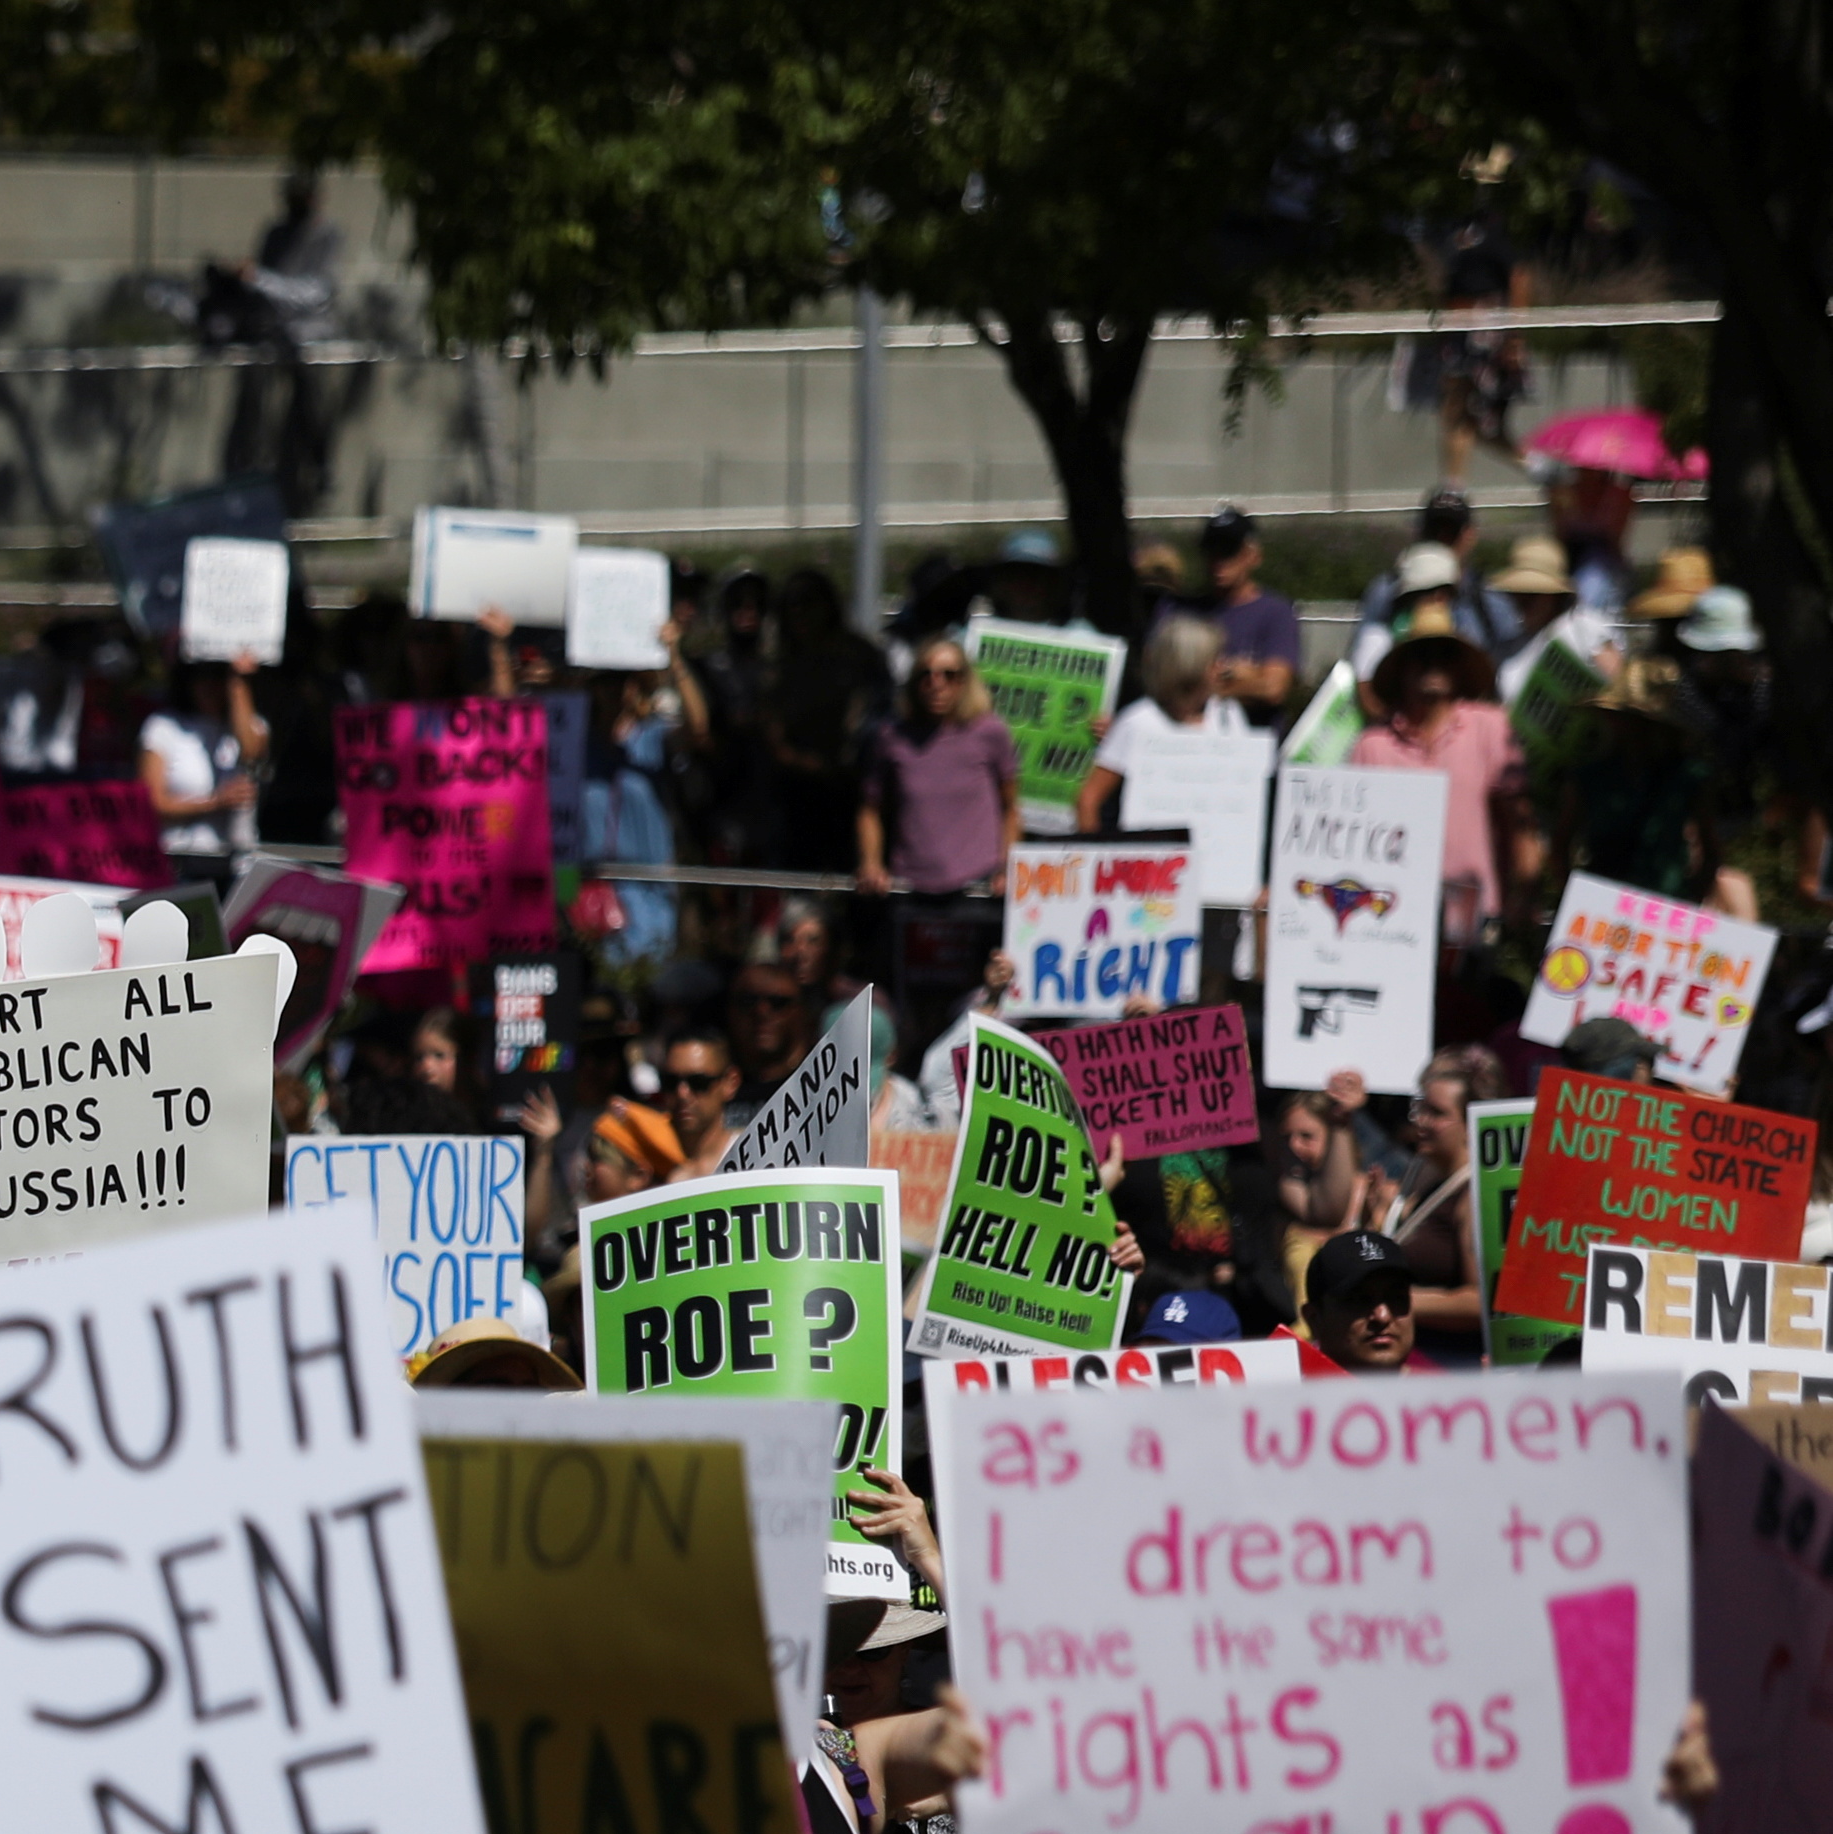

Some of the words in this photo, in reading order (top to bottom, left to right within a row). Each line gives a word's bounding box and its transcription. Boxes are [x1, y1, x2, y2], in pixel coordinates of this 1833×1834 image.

[124, 972, 214, 1021] ALL
[494, 963, 558, 996] BANS
[1596, 959, 1712, 1019] SAFE
[1076, 1025, 1146, 1062] HATH
[1150, 1014, 1201, 1052] NOT
[1213, 1012, 1233, 1040] A
[1082, 1058, 1169, 1099] SHALL
[1173, 1046, 1243, 1086] SHUT
[152, 1086, 213, 1133] TO
[1200, 1080, 1234, 1113] UP
[1555, 1079, 1627, 1129] NOT
[1633, 1095, 1687, 1139] THE
[1688, 1109, 1809, 1168] CHURCH
[395, 1137, 523, 1246] YOUR
[975, 1115, 1069, 1208] ROE
[1080, 1146, 1107, 1218] ?
[1548, 1117, 1621, 1164] NOT
[1628, 1135, 1682, 1179] THE
[1687, 1147, 1784, 1198] STATE
[1600, 1178, 1740, 1237] WOMEN
[593, 1198, 885, 1294] OVERTURN
[940, 1203, 1041, 1284] HELL
[1043, 1232, 1122, 1306] NO!
[951, 1281, 985, 1309] Rise
[987, 1288, 1013, 1316] Up!
[1014, 1297, 1056, 1327] Raise
[623, 1286, 777, 1397] ROE
[802, 1286, 859, 1374] ?
[983, 1418, 1083, 1488] as
[1126, 1428, 1165, 1474] a
[986, 1508, 1003, 1587] I
[1124, 1503, 1435, 1597] dream
[1501, 1506, 1604, 1574] to
[0, 1483, 410, 1737] SENT
[982, 1608, 1138, 1682] have
[1193, 1612, 1276, 1674] the
[1309, 1608, 1450, 1675] same
[981, 1683, 1345, 1830] rights
[1428, 1694, 1520, 1777] as
